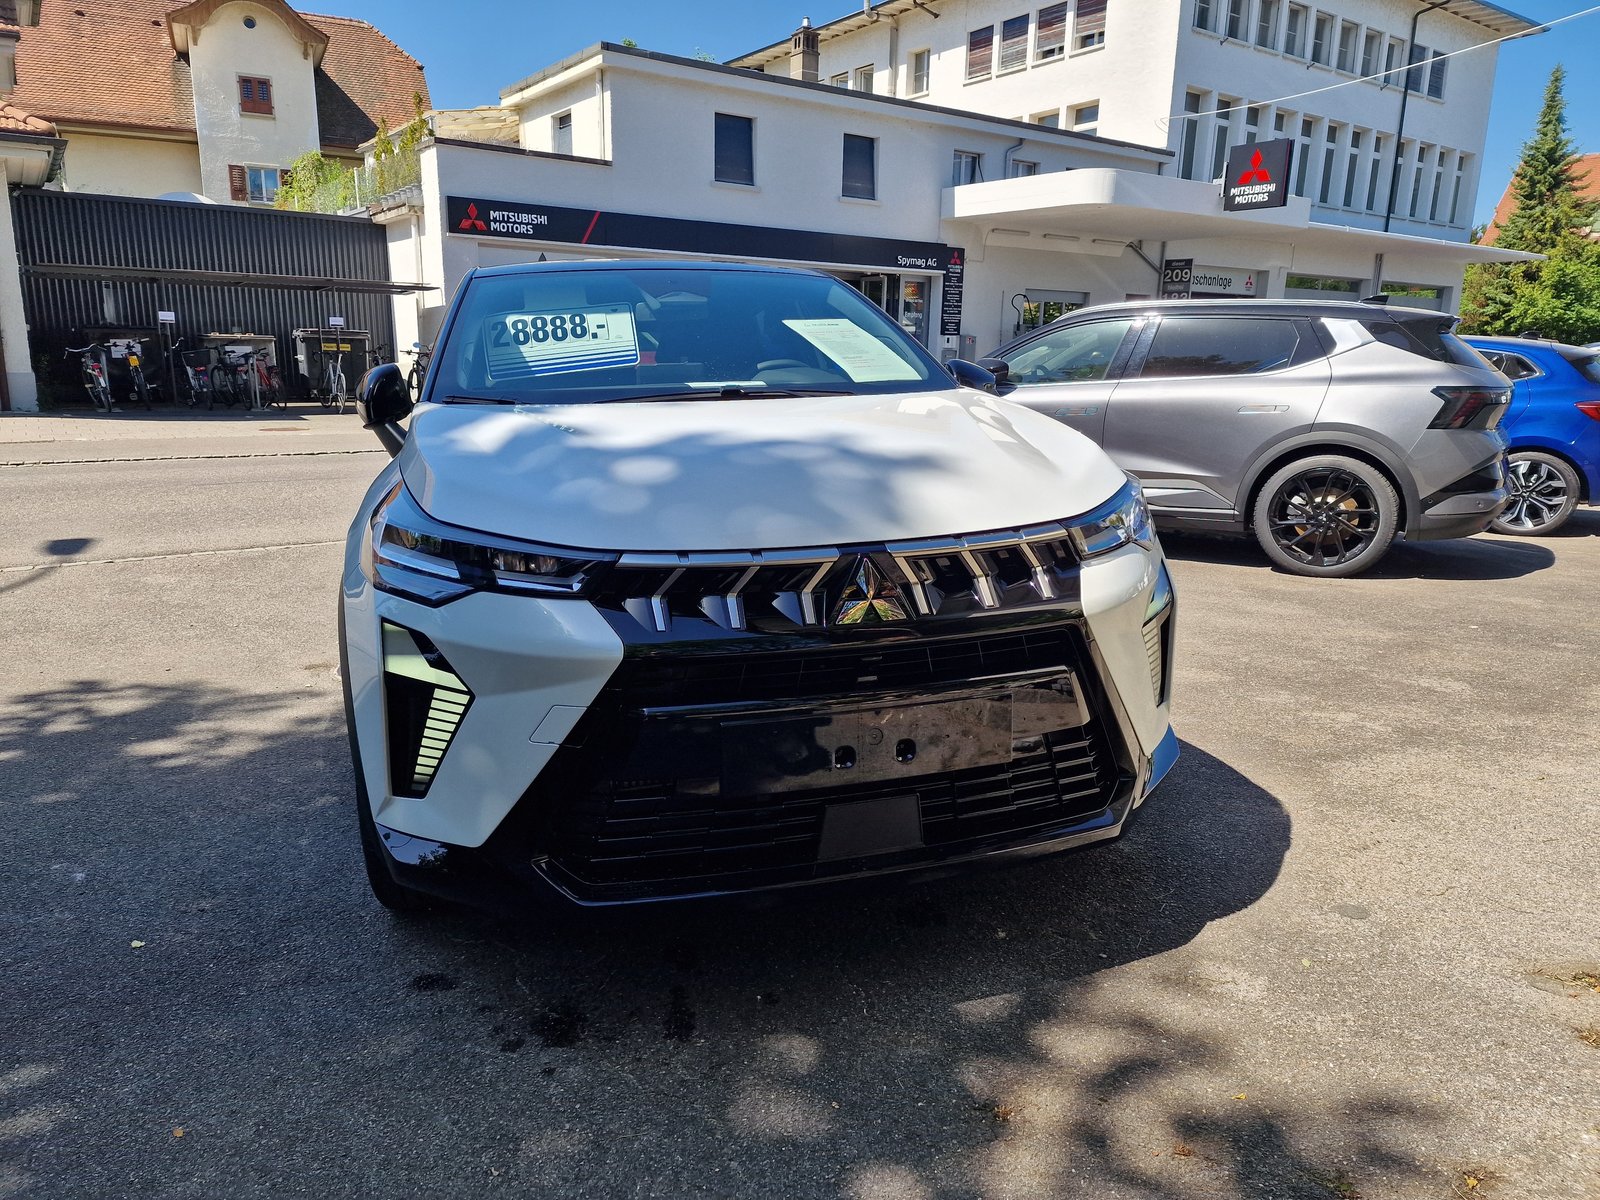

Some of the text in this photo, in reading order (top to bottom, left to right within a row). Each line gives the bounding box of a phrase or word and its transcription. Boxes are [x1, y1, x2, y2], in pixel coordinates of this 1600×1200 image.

[1230, 183, 1276, 196] MITSUBISHI
[1234, 193, 1269, 204] MOTORS
[490, 210, 548, 225] MITSUBISHI
[490, 221, 534, 235] MOTORS
[897, 255, 926, 267] Spymag
[927, 258, 937, 267] AG
[1163, 269, 1191, 282] 209
[491, 313, 606, 348] 28888.-
